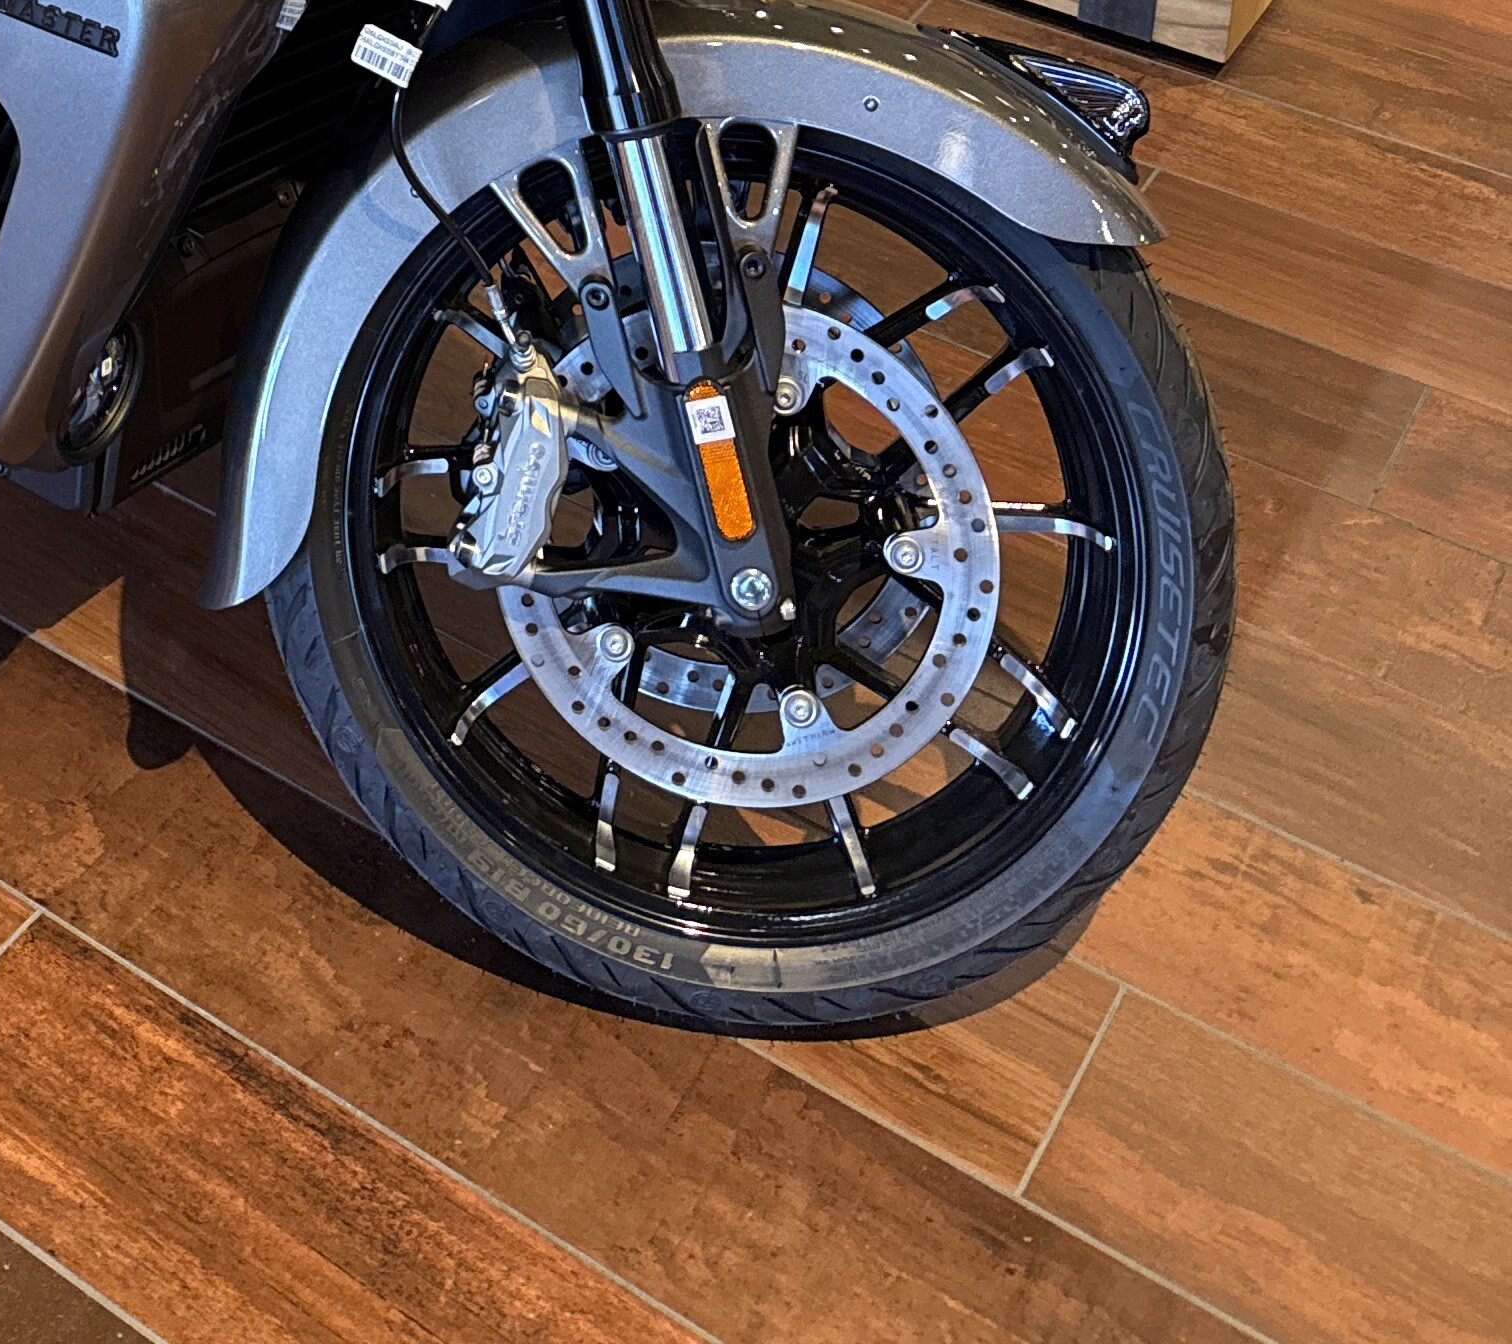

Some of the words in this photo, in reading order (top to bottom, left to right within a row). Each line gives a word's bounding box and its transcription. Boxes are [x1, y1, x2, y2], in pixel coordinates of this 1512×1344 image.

[497, 442, 546, 547] brembo
[1126, 399, 1185, 744] CRUISETEC
[467, 851, 530, 902] B19
[536, 903, 674, 970] 130/60
